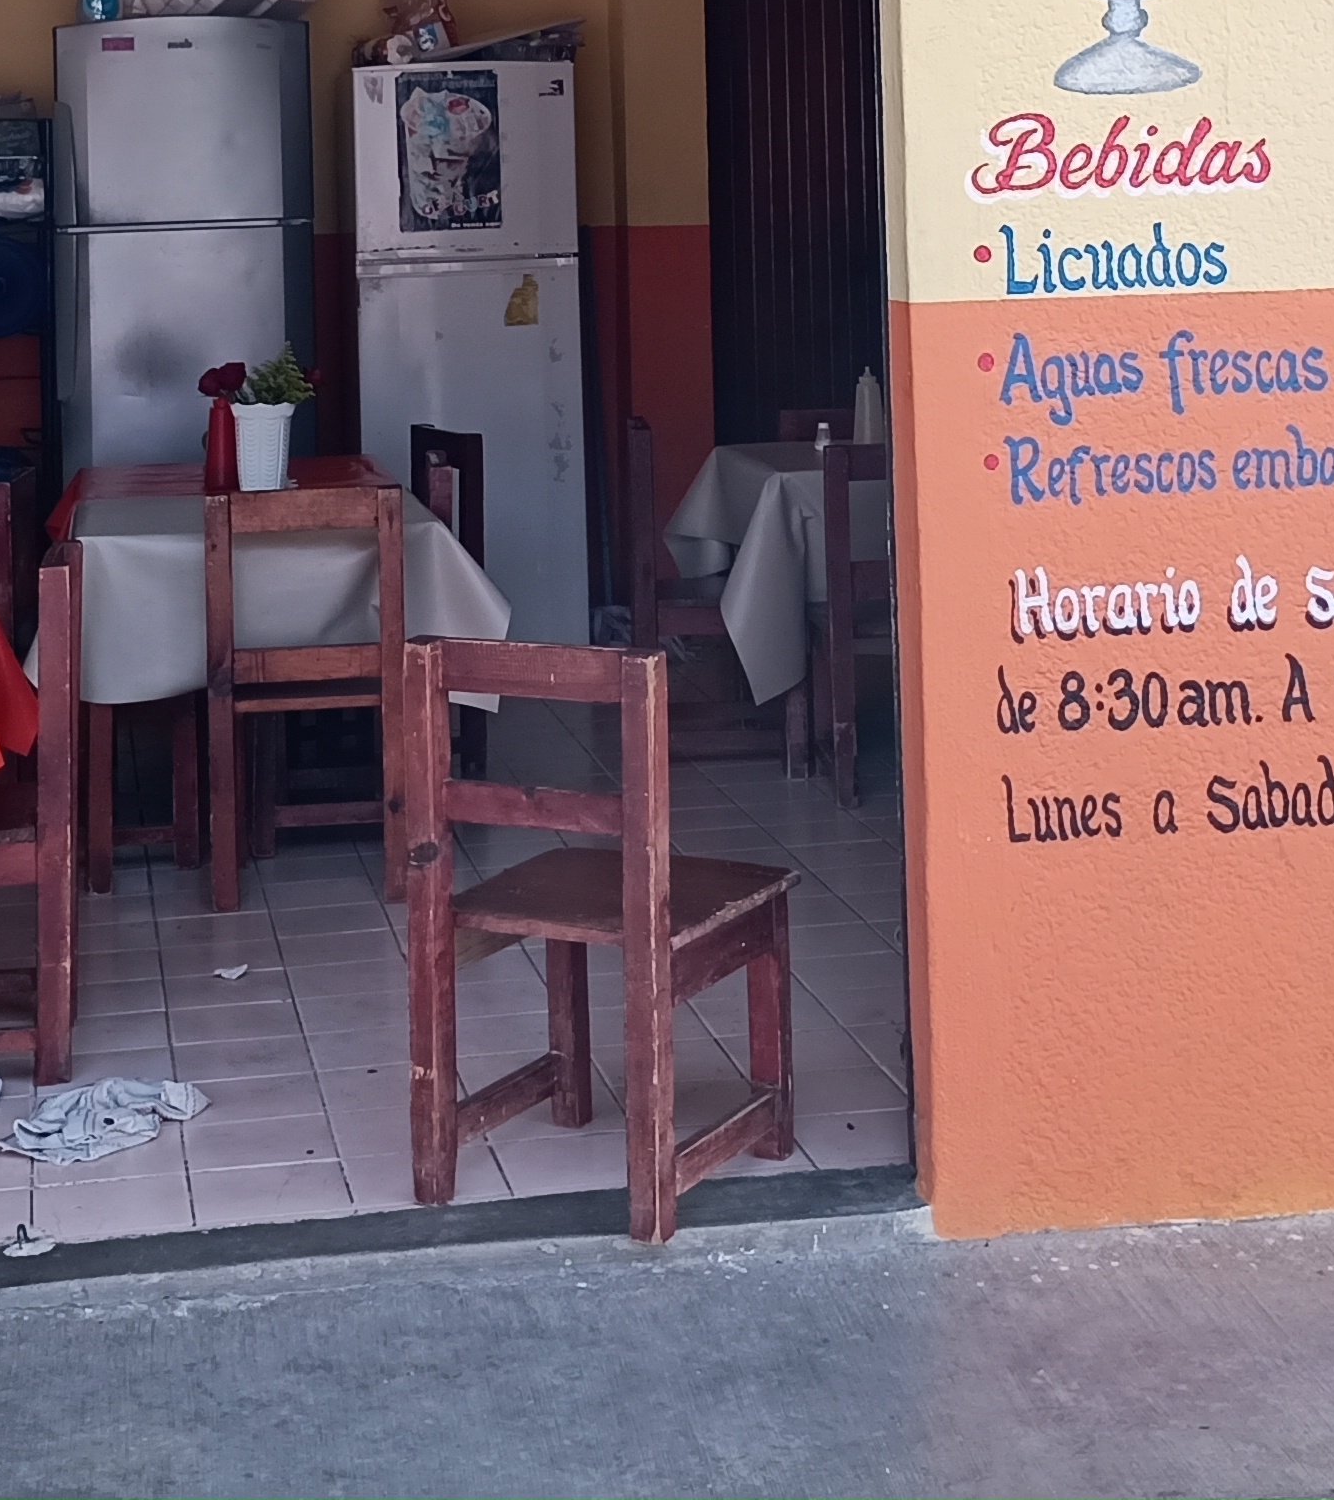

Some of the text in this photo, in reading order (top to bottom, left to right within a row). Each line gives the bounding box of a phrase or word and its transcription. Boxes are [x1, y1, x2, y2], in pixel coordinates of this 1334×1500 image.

[967, 112, 1272, 200] Bebidas
[999, 222, 1229, 296] Licuados
[998, 330, 1330, 427] Aguas frescas
[1003, 435, 1218, 506] Refrescos
[1008, 564, 1202, 643] Horario
[1228, 554, 1279, 632] de
[997, 665, 1037, 735] de
[1281, 653, 1316, 723] A
[1001, 775, 1124, 843] Lunes
[1153, 789, 1178, 835] a
